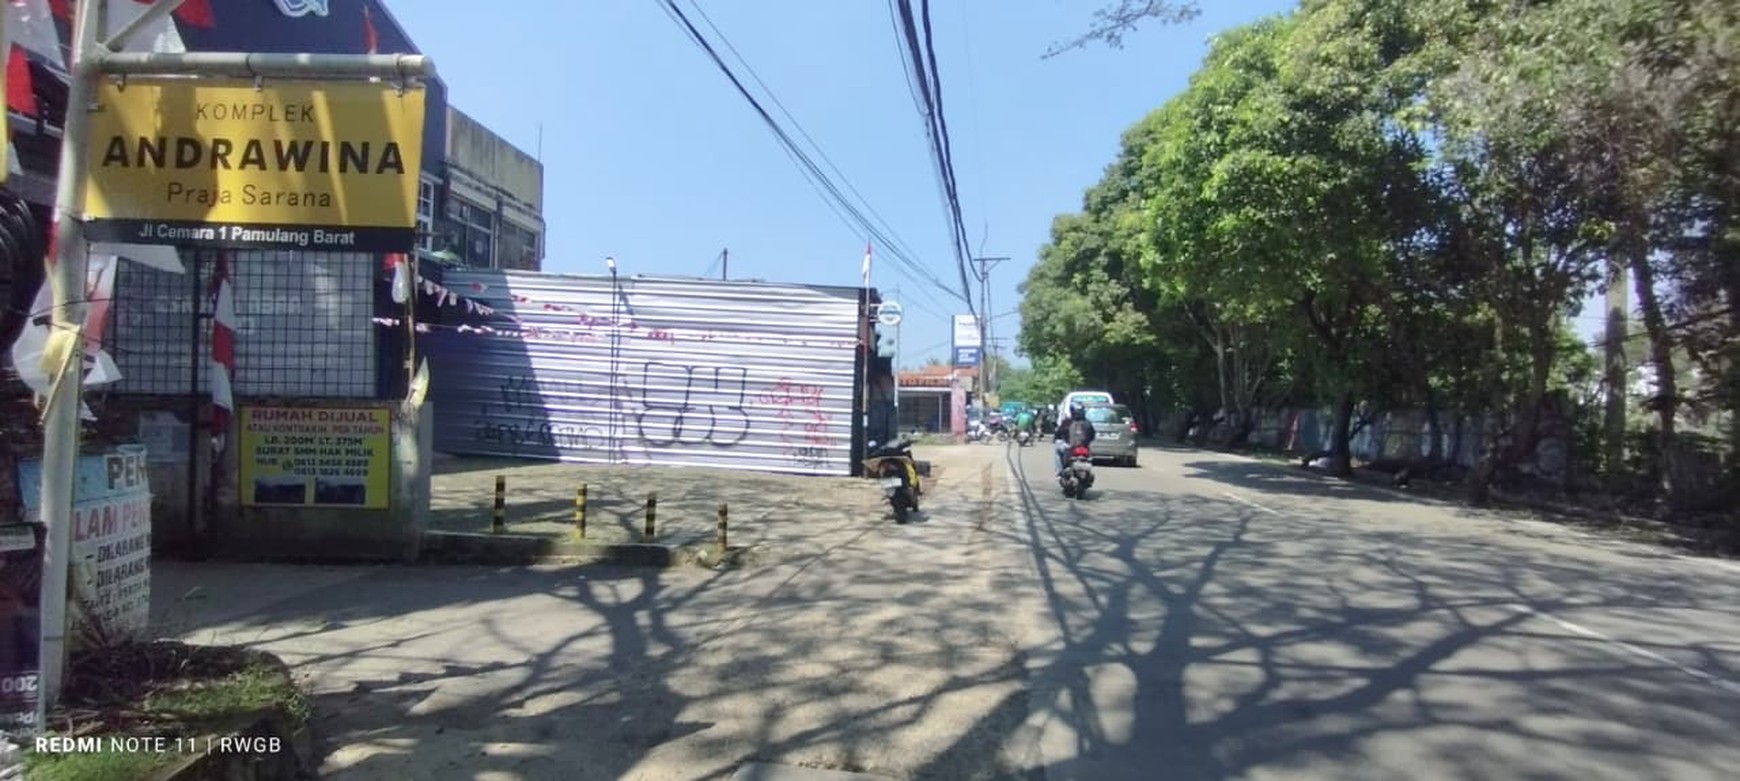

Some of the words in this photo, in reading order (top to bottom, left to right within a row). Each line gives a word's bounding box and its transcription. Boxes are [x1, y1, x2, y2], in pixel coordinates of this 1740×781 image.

[196, 102, 315, 122] KOMPLEK
[102, 136, 405, 174] ANDRAWINA
[167, 182, 231, 208] Praja
[241, 184, 332, 208] Sarana
[156, 224, 213, 241] Cemara
[219, 227, 226, 241] 1
[231, 228, 310, 245] Pamulang
[313, 230, 355, 245] Barat
[252, 410, 312, 421] RUMAH
[318, 411, 378, 422] DIJUAL
[345, 448, 375, 457] MILIK
